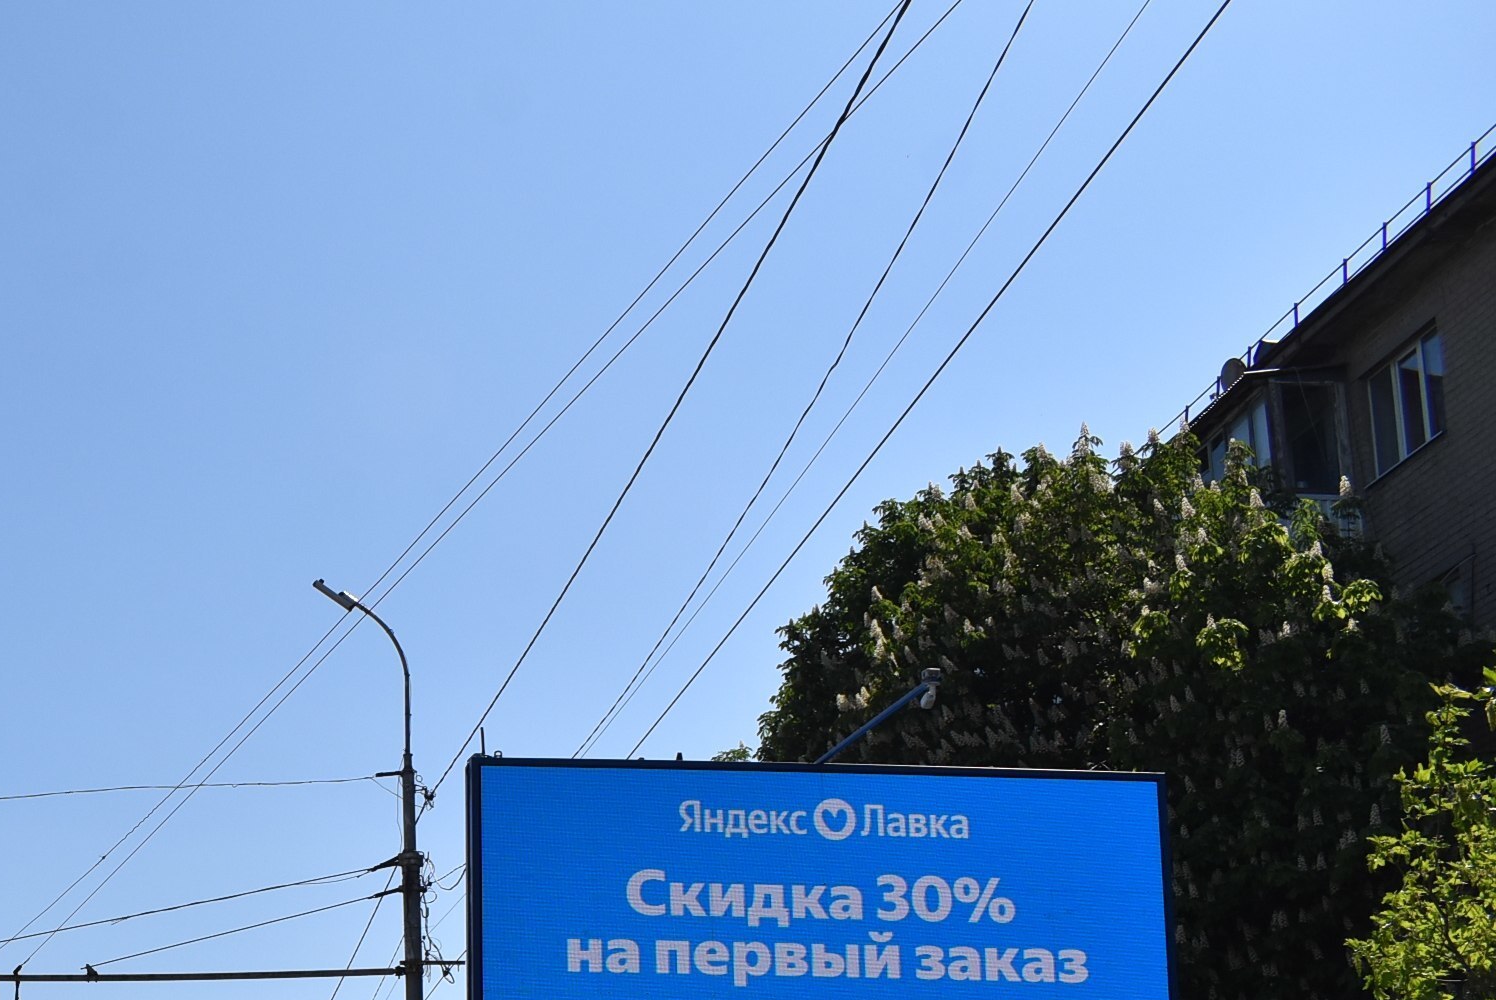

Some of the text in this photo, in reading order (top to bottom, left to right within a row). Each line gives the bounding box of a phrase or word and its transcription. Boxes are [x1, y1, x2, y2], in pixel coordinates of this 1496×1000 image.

[678, 799, 970, 840] Яндекс Лавка
[625, 868, 1016, 927] Скидка 30%
[566, 930, 1090, 987] на первый заказ
